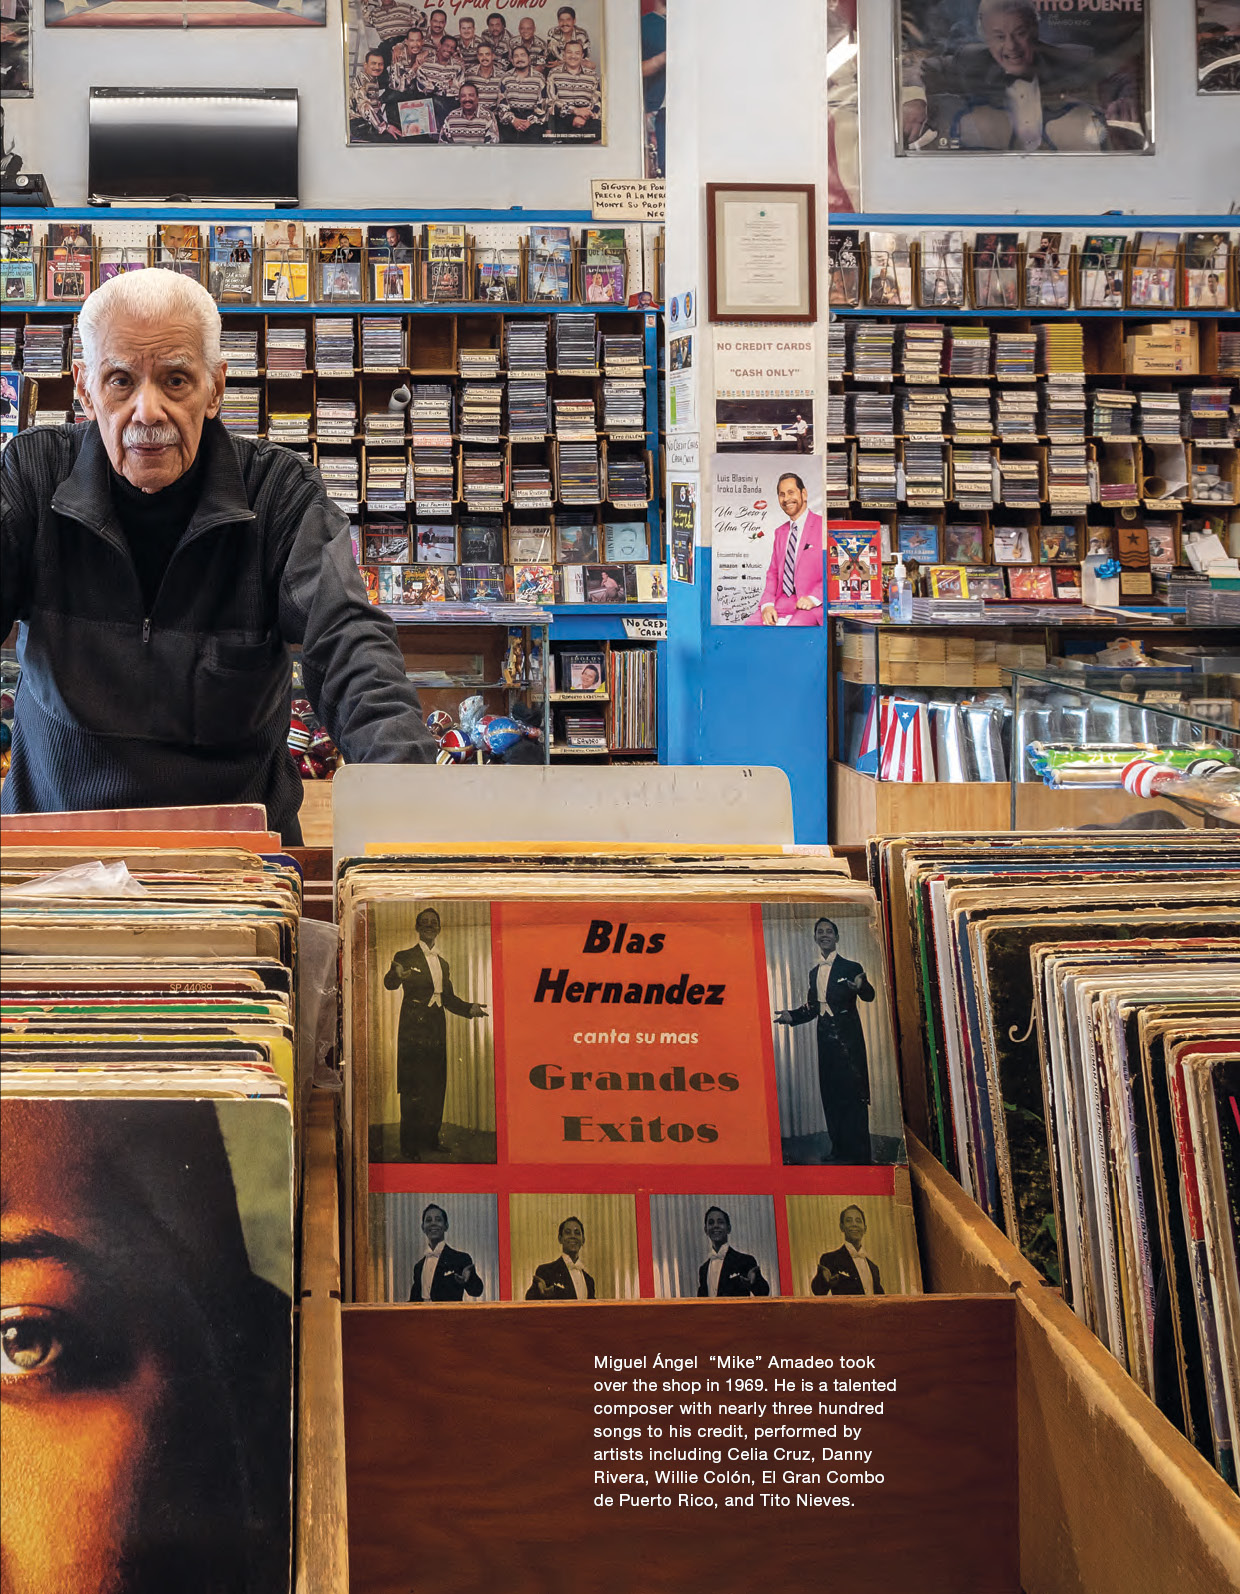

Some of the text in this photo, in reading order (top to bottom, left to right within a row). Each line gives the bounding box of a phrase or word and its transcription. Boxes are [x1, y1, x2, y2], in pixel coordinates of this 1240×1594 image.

[1078, 0, 1142, 11] PUENTE
[717, 343, 812, 351] NO CREDIT CARDS
[730, 369, 800, 377] "CASH ONLY"
[717, 474, 730, 482] Luis
[732, 474, 753, 482] Blasini
[717, 485, 762, 493] Iroko La Banda
[715, 506, 767, 520] Un Beso y
[715, 522, 761, 532] Una Flor
[582, 919, 666, 954] Blas
[169, 983, 213, 992] SP 44089
[533, 967, 726, 1006] Hernandez
[573, 1028, 699, 1045] canta su mas
[529, 1063, 740, 1092] Grandes
[561, 1115, 719, 1143] Exitos
